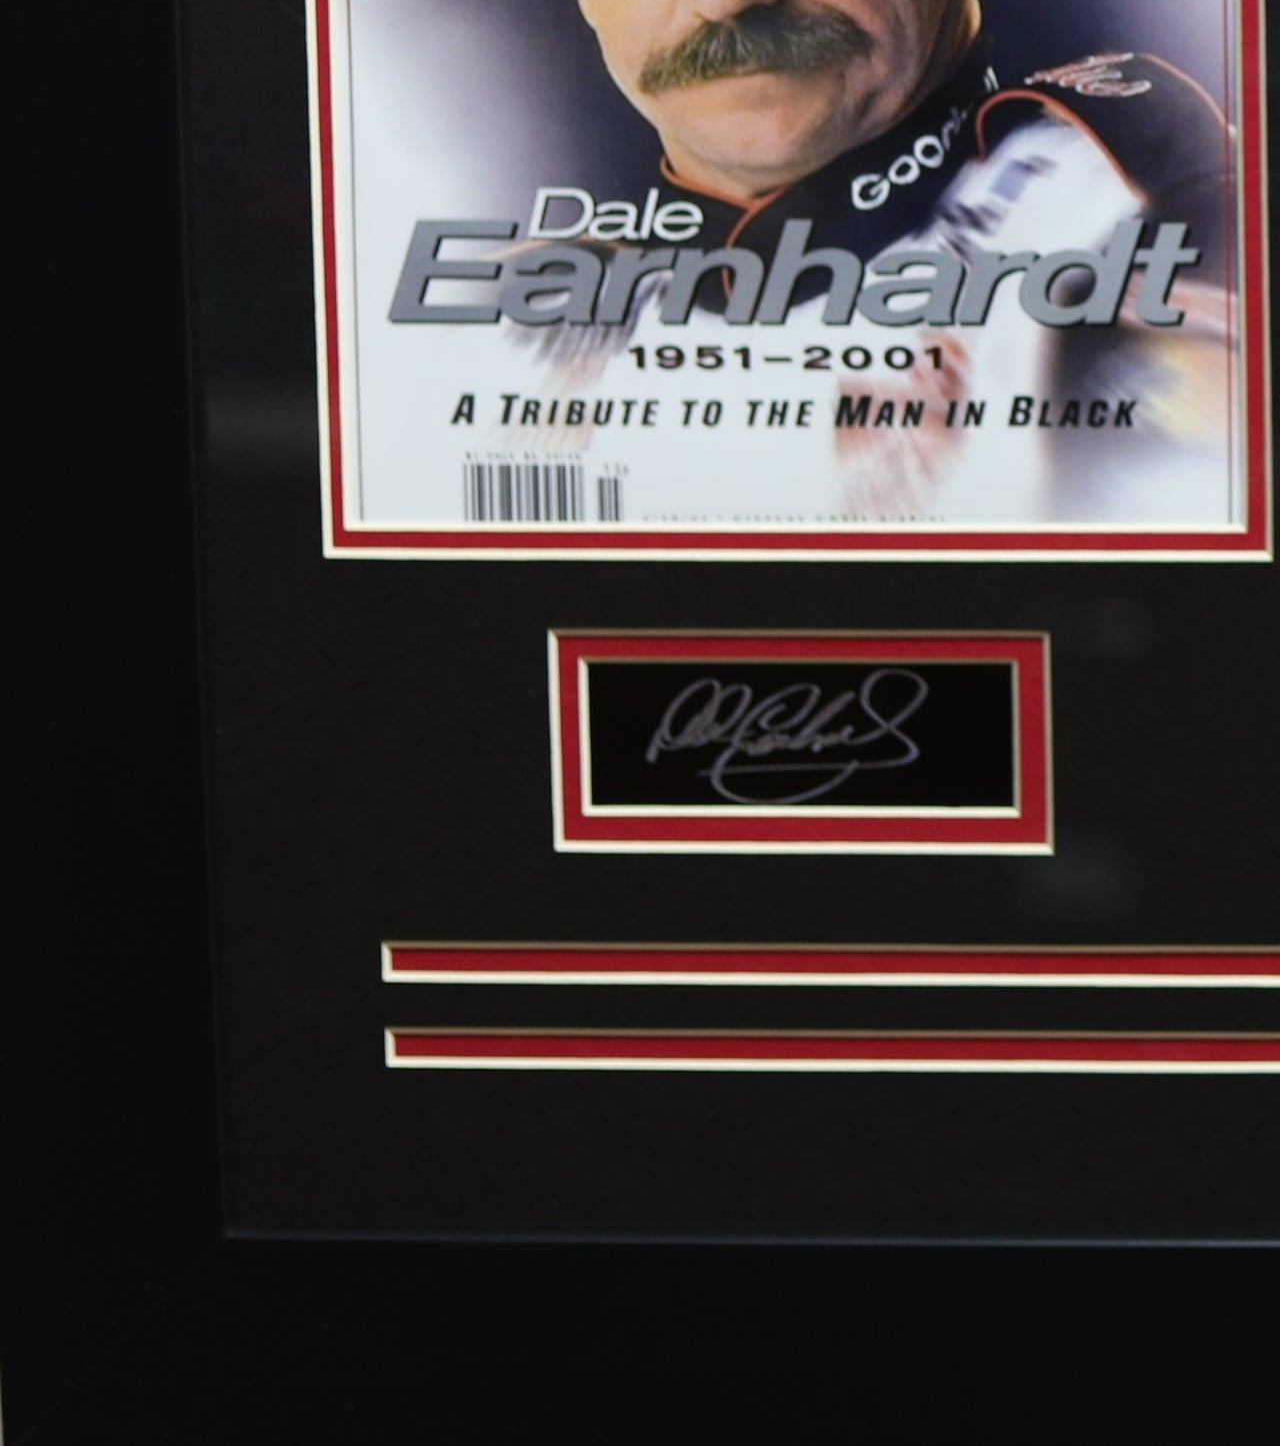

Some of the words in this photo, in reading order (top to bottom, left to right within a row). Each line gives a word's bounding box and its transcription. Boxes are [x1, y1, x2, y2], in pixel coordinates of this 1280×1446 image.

[528, 187, 702, 240] Dale
[388, 218, 1201, 326] Earnhardt
[452, 395, 474, 426] A
[499, 393, 658, 426] TRIBUTE
[681, 398, 722, 426] TO
[747, 398, 812, 426] THE
[835, 395, 924, 427] MAN
[946, 397, 983, 426] IN
[1008, 394, 1136, 427] BLACK
